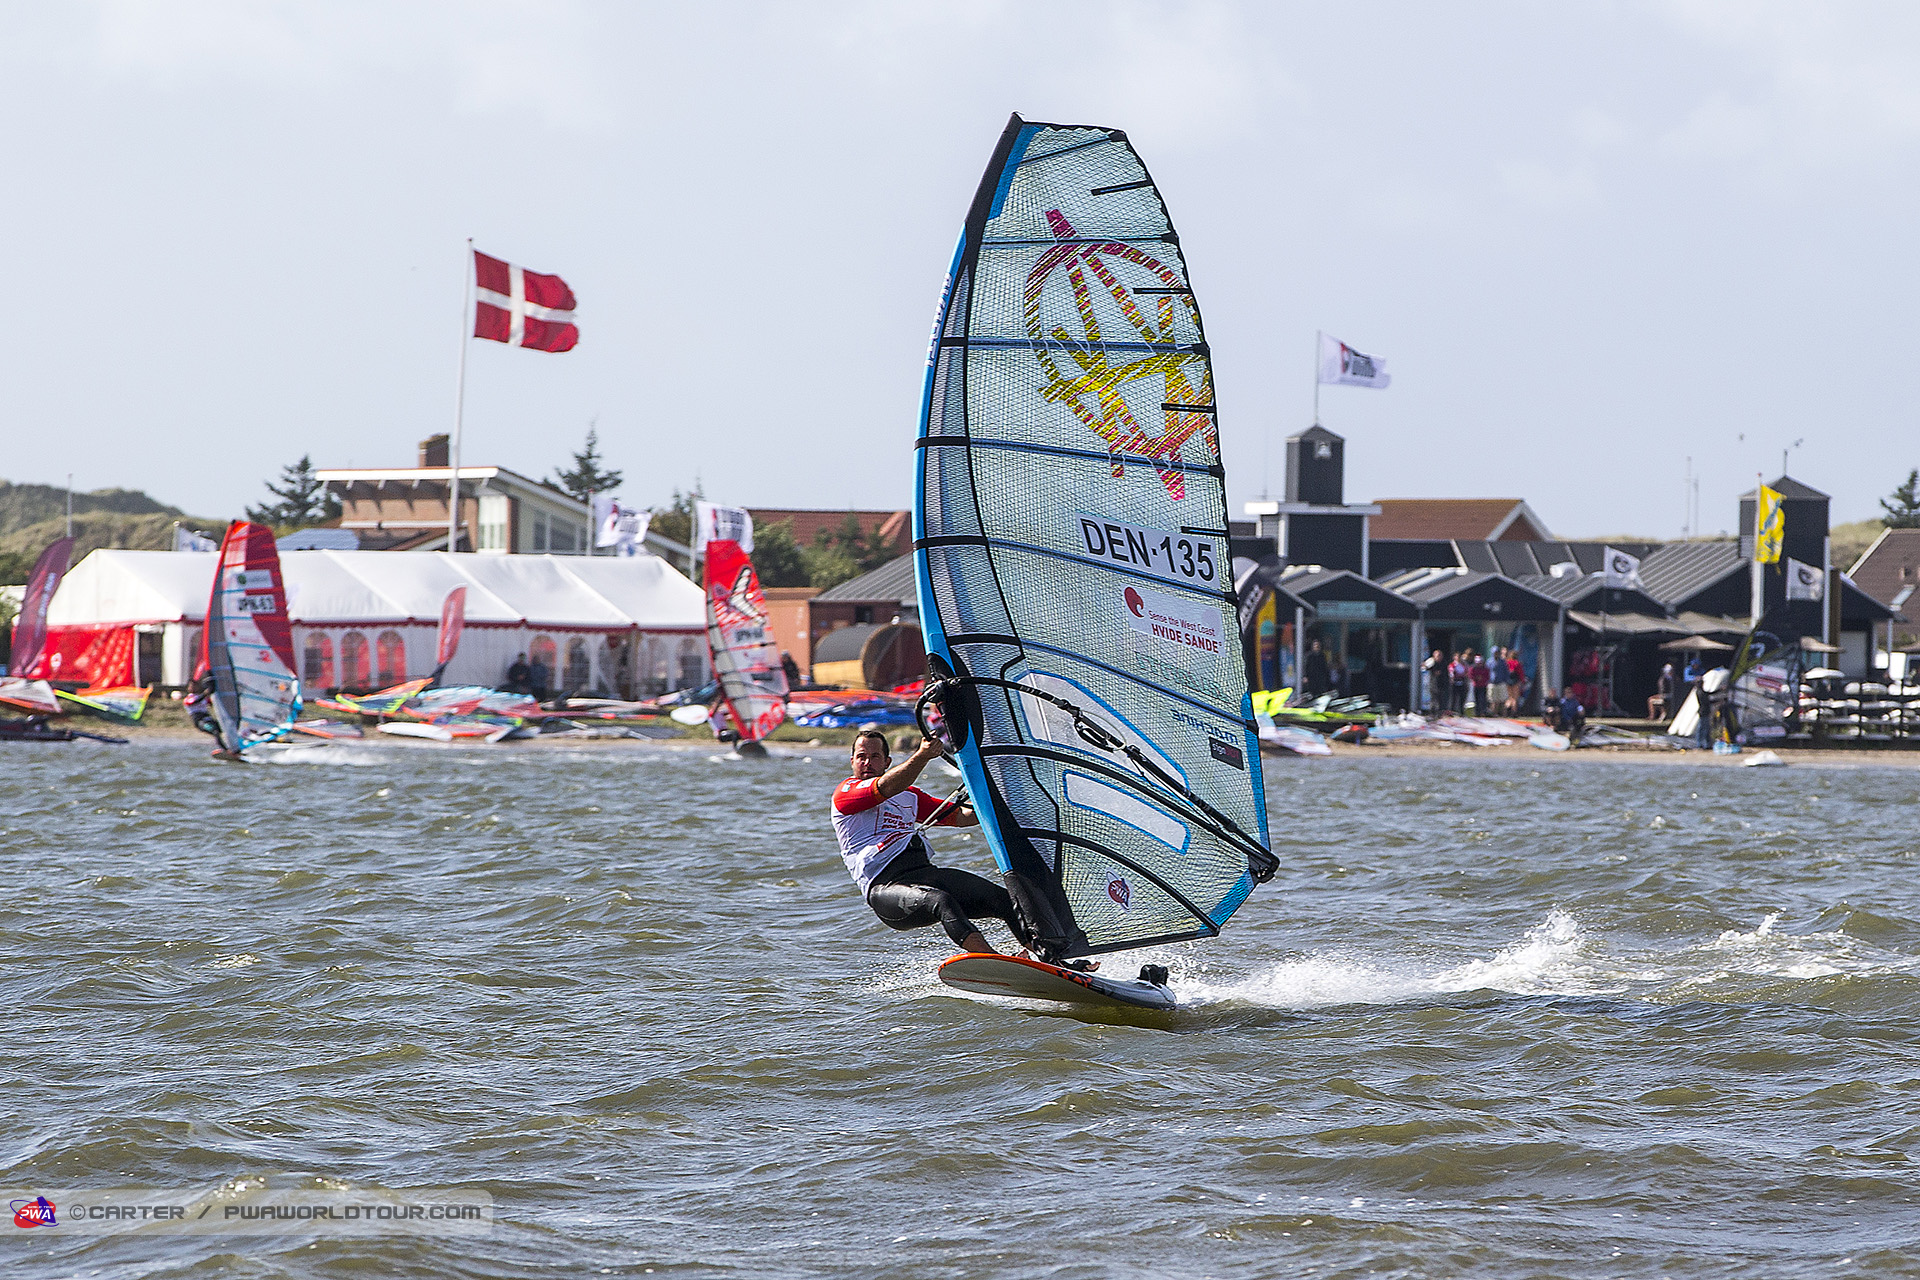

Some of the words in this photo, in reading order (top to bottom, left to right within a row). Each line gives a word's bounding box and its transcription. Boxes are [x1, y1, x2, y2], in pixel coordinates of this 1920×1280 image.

[1148, 610, 1168, 624] Sense
[1168, 617, 1180, 627] the
[1180, 619, 1197, 632] West
[1197, 623, 1216, 637] Coast
[1151, 623, 1183, 643] HVIDE
